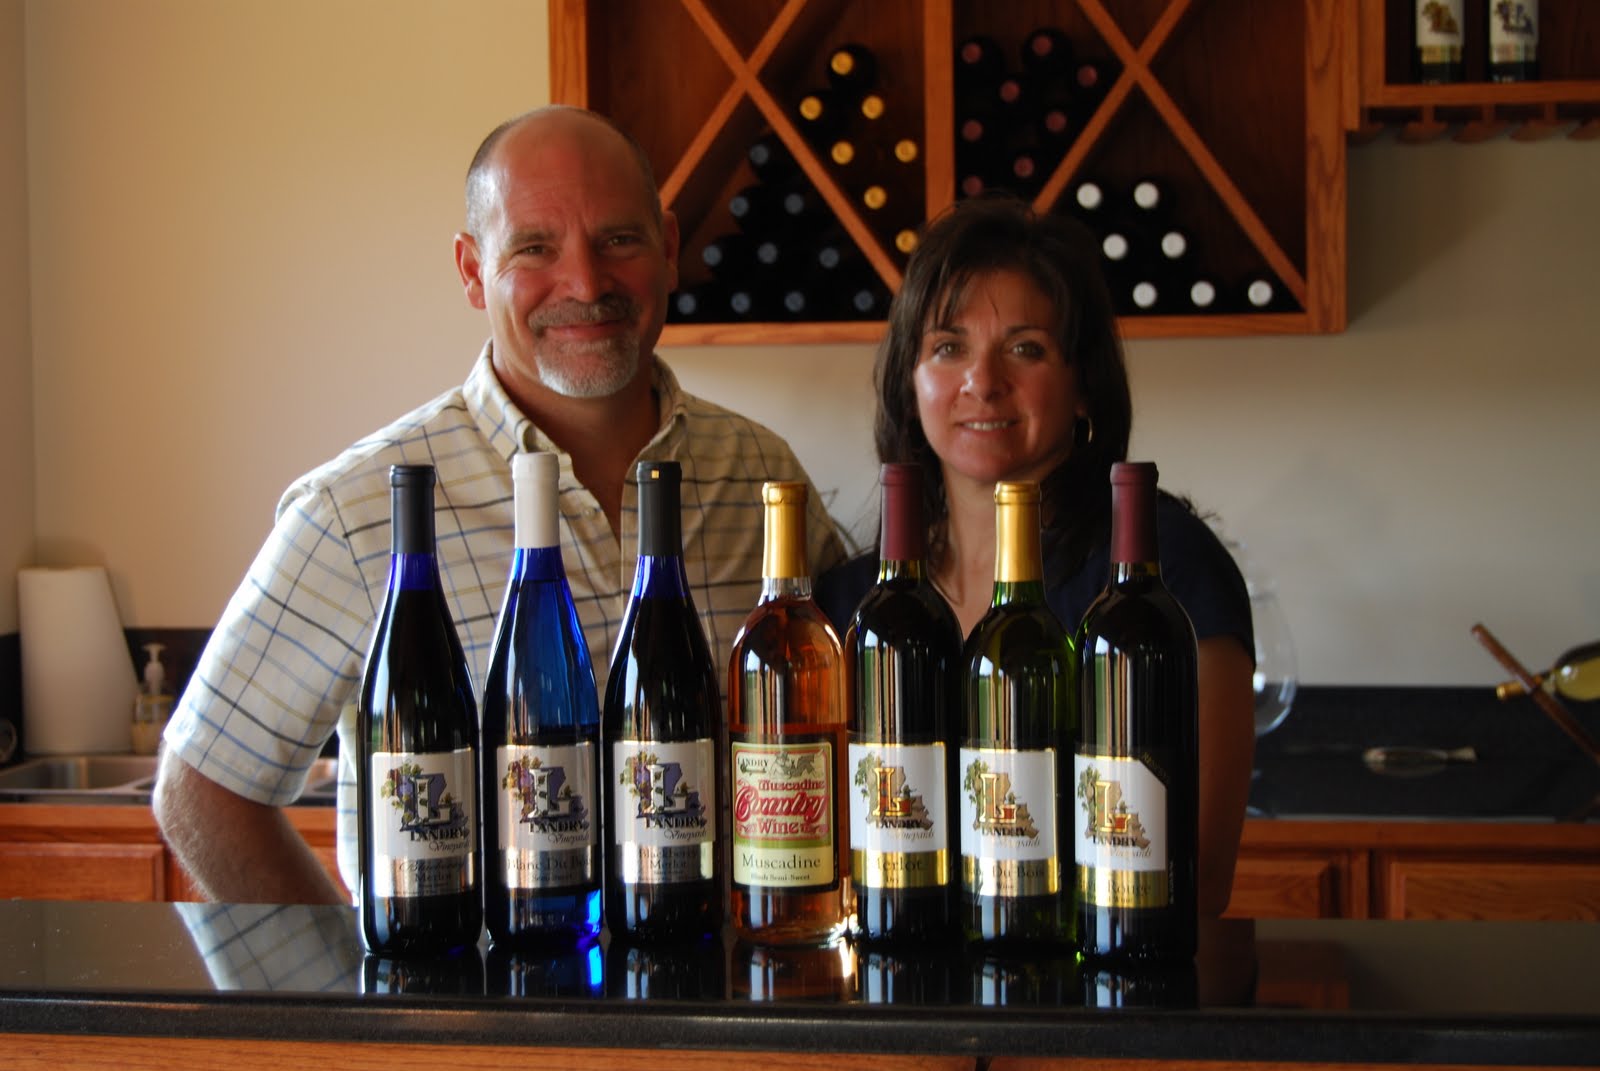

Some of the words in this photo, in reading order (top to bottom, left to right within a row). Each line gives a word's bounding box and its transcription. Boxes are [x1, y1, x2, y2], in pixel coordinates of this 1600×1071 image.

[738, 757, 768, 769] LANDRY
[759, 779, 827, 791] Muscadine
[735, 786, 829, 823] Country
[529, 820, 585, 833] LANDRY
[646, 816, 703, 829] LANDRY
[757, 817, 800, 834] Wine
[410, 827, 467, 841] LANDRY
[742, 853, 821, 869] Muscadine
[877, 857, 922, 872] erlot
